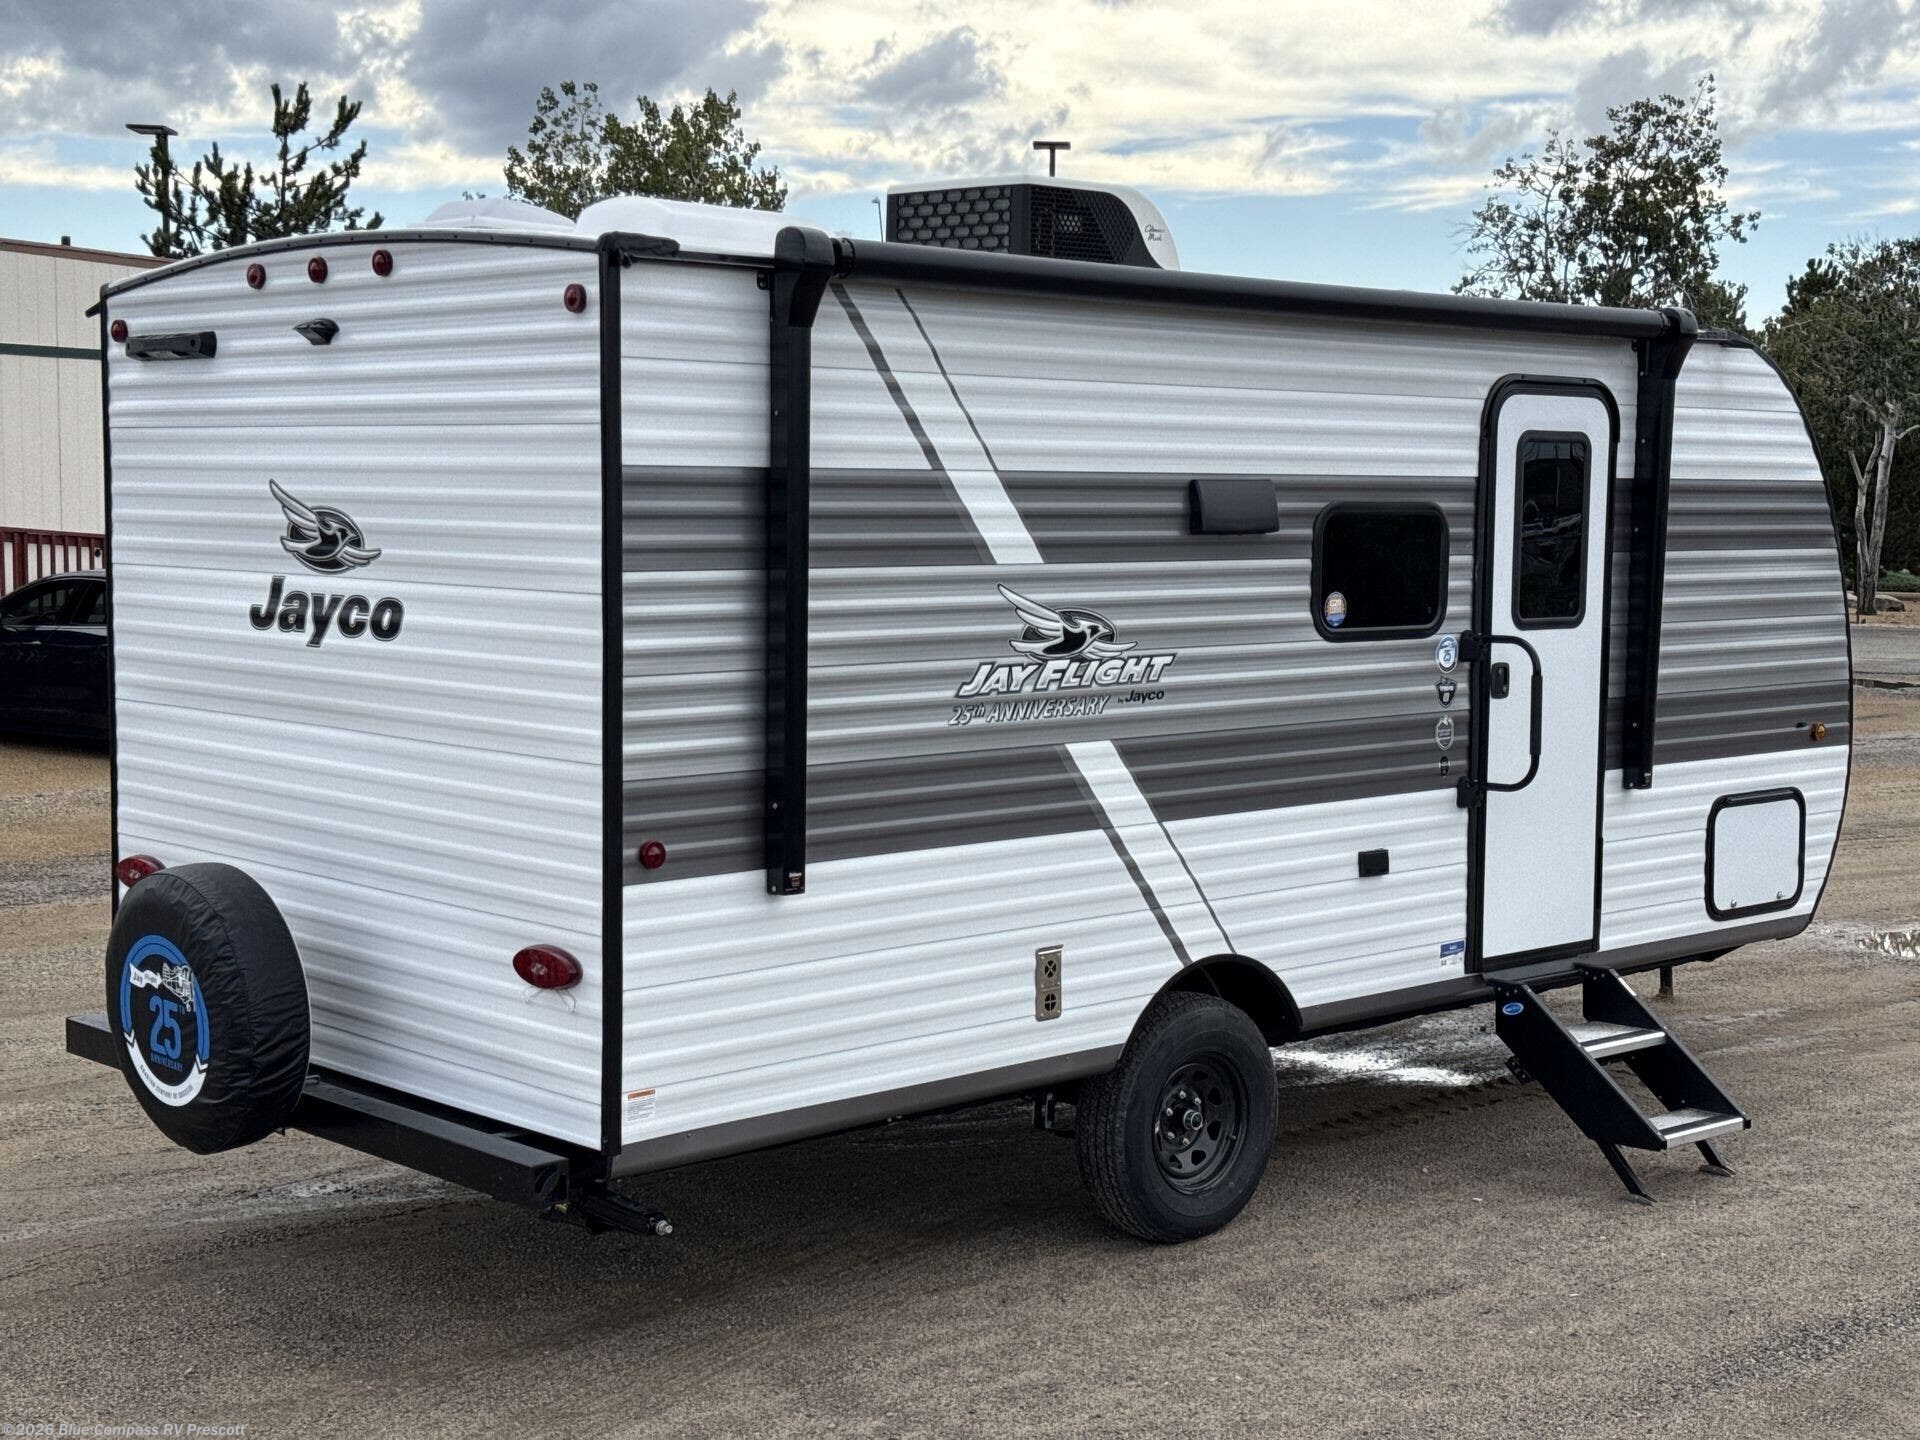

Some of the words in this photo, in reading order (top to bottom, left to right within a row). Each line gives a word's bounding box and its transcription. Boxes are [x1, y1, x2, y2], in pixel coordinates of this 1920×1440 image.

[249, 575, 404, 647] Jayco
[954, 661, 1039, 699] JAY
[1034, 652, 1178, 692] FLIGHT
[948, 703, 986, 726] 25th
[986, 694, 1112, 723] ANNIVERSARY
[1124, 689, 1166, 704] Jayco
[151, 1053, 183, 1071] ANNIVERSARY
